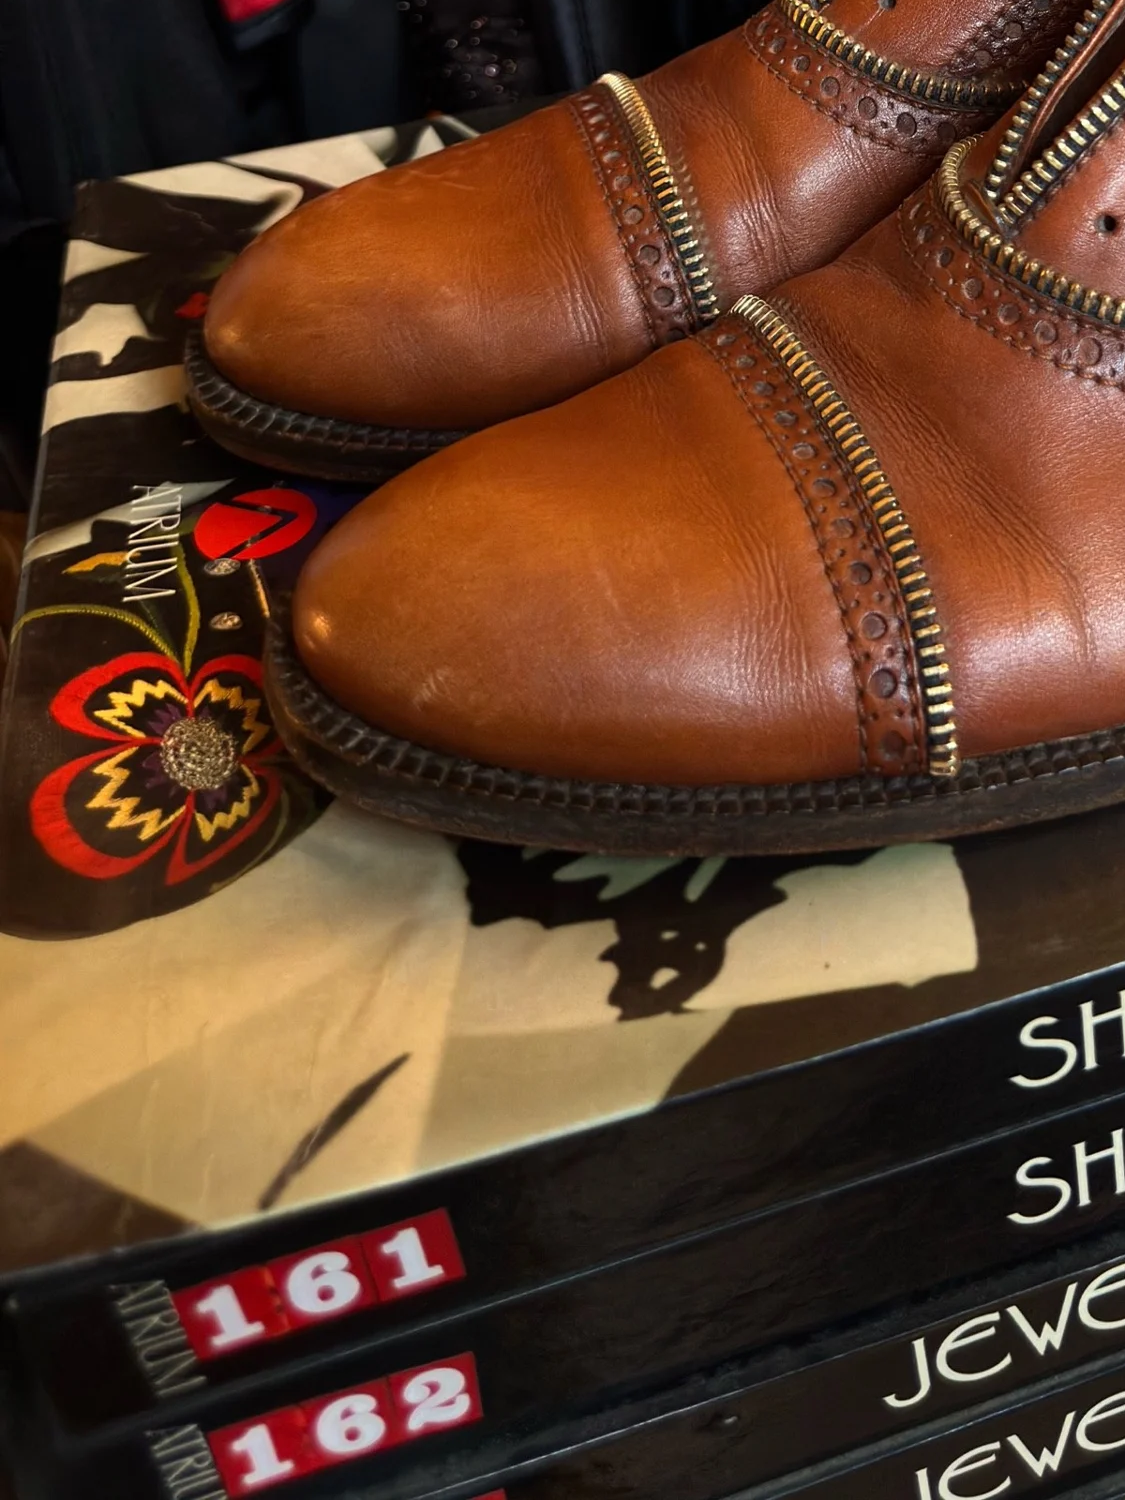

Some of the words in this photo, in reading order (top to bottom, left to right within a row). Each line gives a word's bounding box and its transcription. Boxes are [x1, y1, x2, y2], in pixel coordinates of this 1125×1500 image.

[122, 484, 184, 602] ATRIUM
[109, 1279, 207, 1396] ATRIUM
[196, 1227, 444, 1349] 161
[143, 1423, 228, 1500] ATRIU
[231, 1367, 471, 1485] 162
